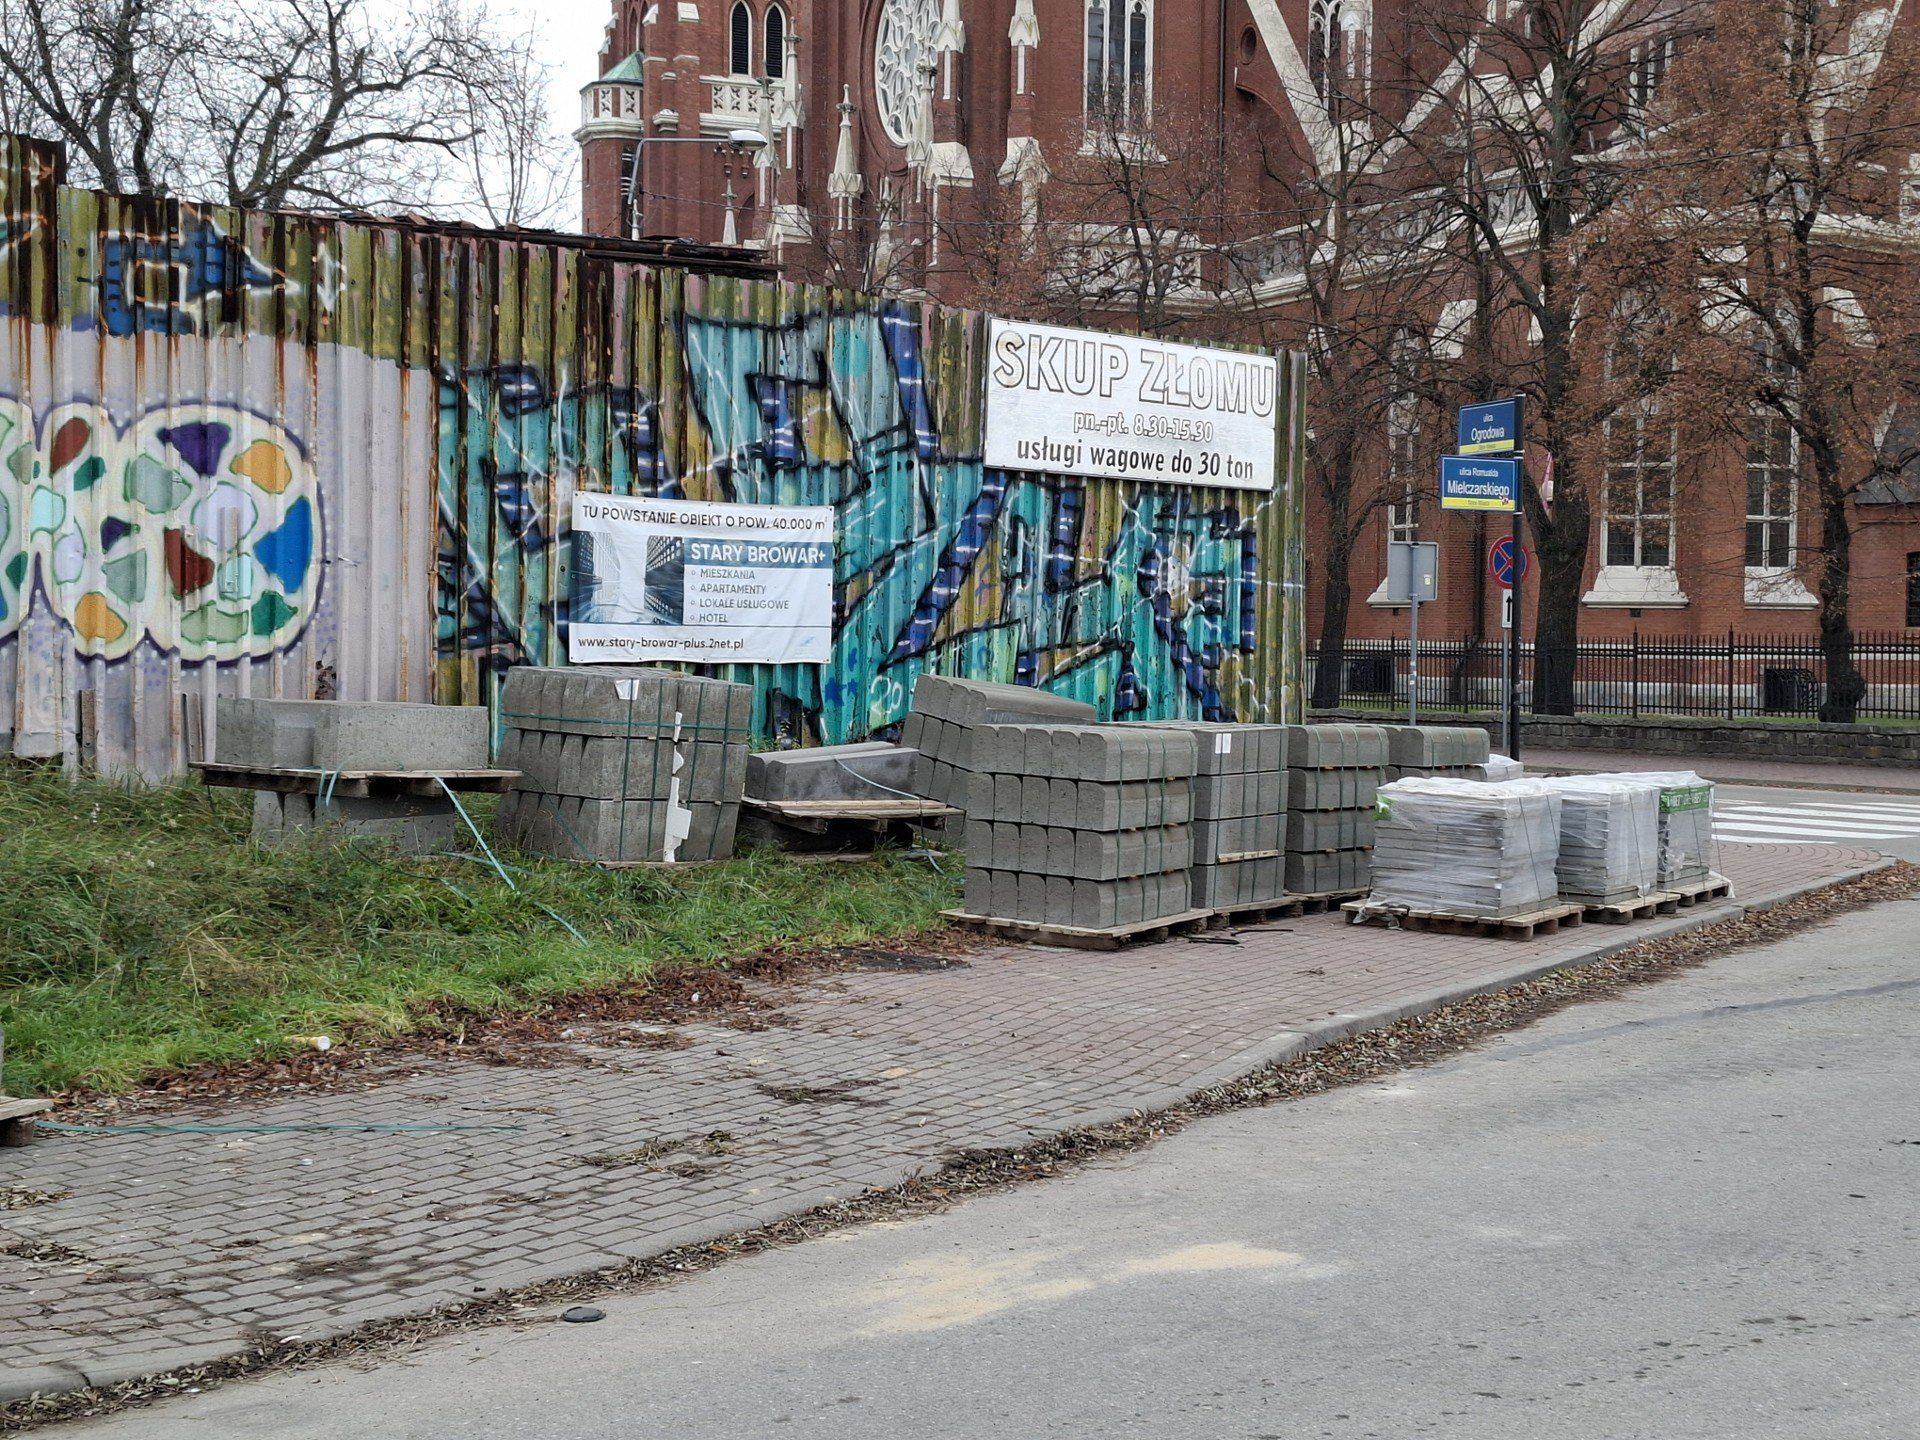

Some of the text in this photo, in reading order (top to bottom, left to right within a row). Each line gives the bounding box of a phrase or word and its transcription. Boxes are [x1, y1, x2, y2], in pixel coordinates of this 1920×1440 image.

[993, 330, 1274, 417] SKUP ZŁOMU
[1133, 414, 1213, 442] 8.30-15.30
[1471, 425, 1505, 444] Ogrodowa
[1017, 436, 1253, 479] usługi wagowe do 30 ton
[1460, 467, 1471, 475] ulica
[1447, 480, 1510, 499] Mielczarskiego
[582, 505, 598, 518] TU
[601, 507, 676, 524] POWSTANIE
[680, 513, 722, 527] OBIEKT
[726, 516, 735, 527] O
[738, 517, 769, 528] POW.
[772, 518, 812, 530] 40.000
[690, 543, 826, 564] STARY BROWAR+
[700, 569, 755, 580] MIESZKANIA
[699, 583, 766, 595] APARTAMENTY
[699, 598, 735, 609] LOKALE
[699, 612, 728, 623] HOTEL
[578, 637, 744, 650] www.stary-browar-plus.2net.pl
